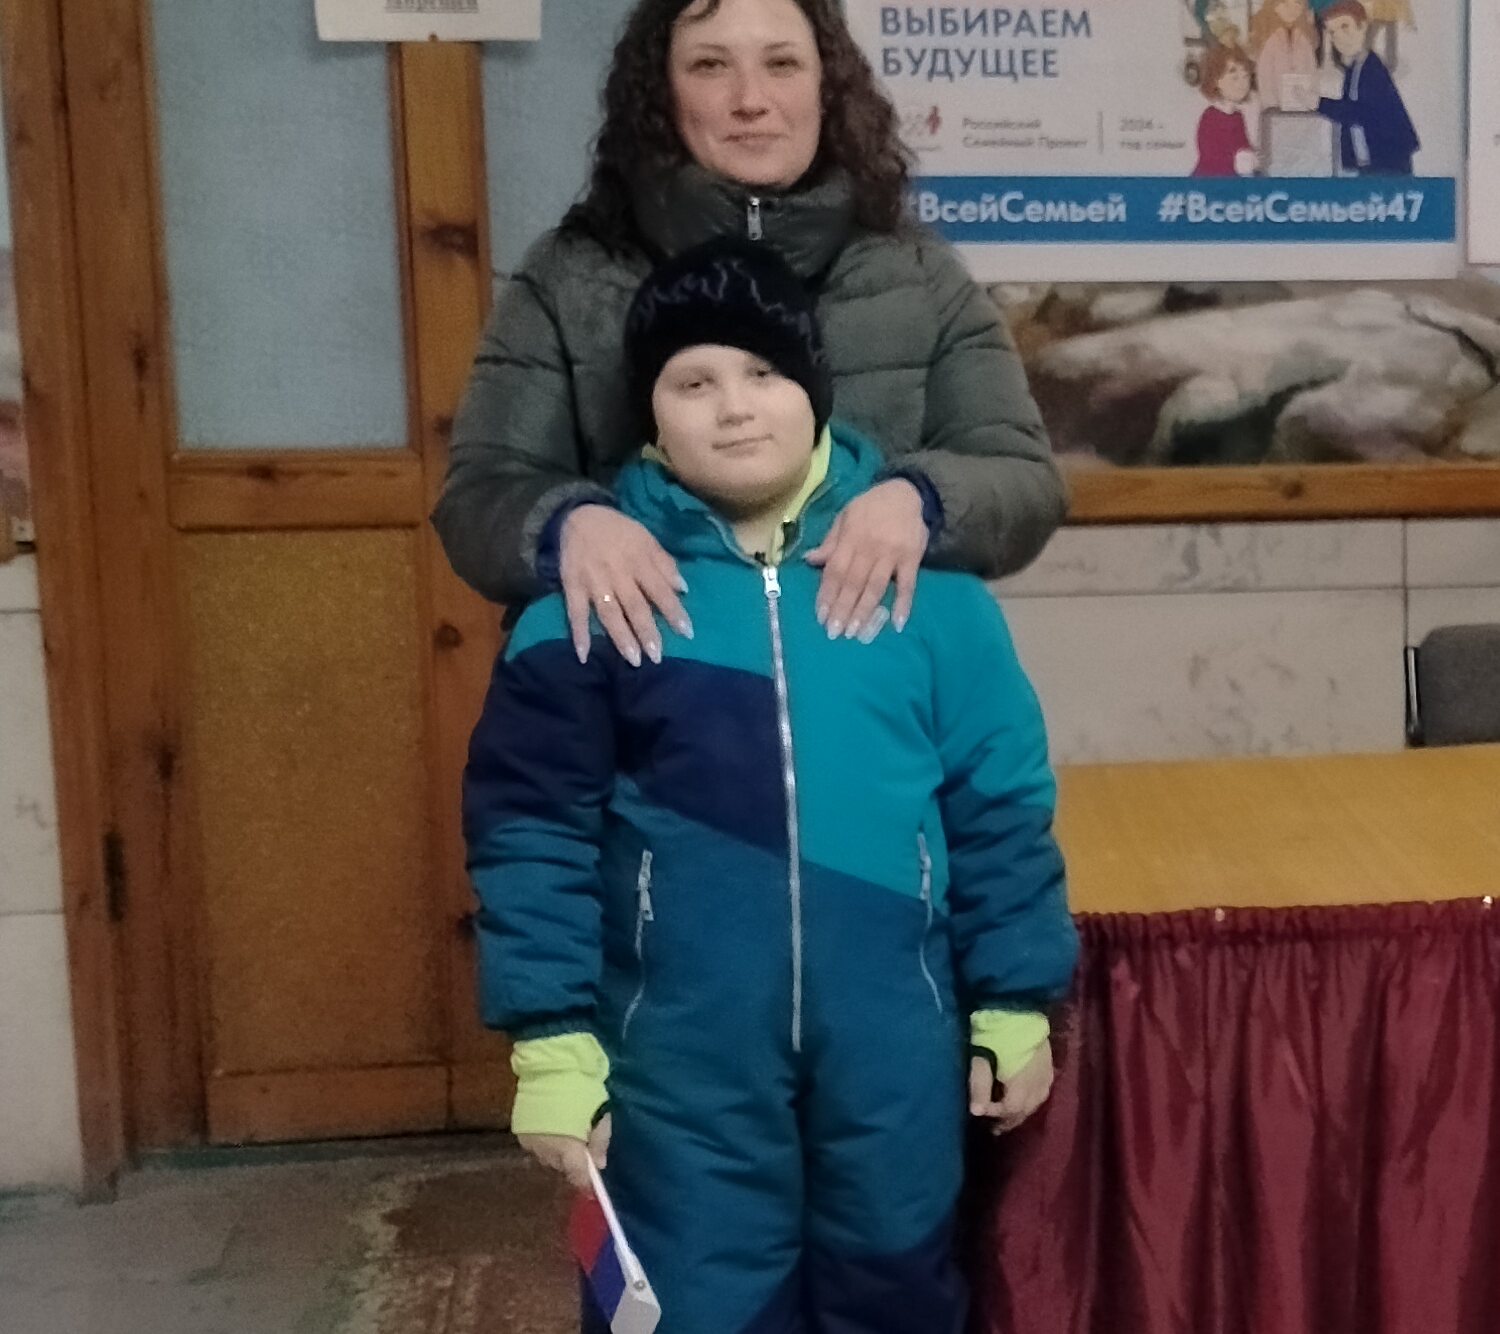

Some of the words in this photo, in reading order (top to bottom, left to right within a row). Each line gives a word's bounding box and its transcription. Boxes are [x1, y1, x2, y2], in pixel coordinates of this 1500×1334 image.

[880, 6, 1093, 39] ВЫБИРАЕМ
[881, 46, 1060, 83] БУДУЩЕЕ
[1157, 191, 1424, 224] #ВсейСемьей47
